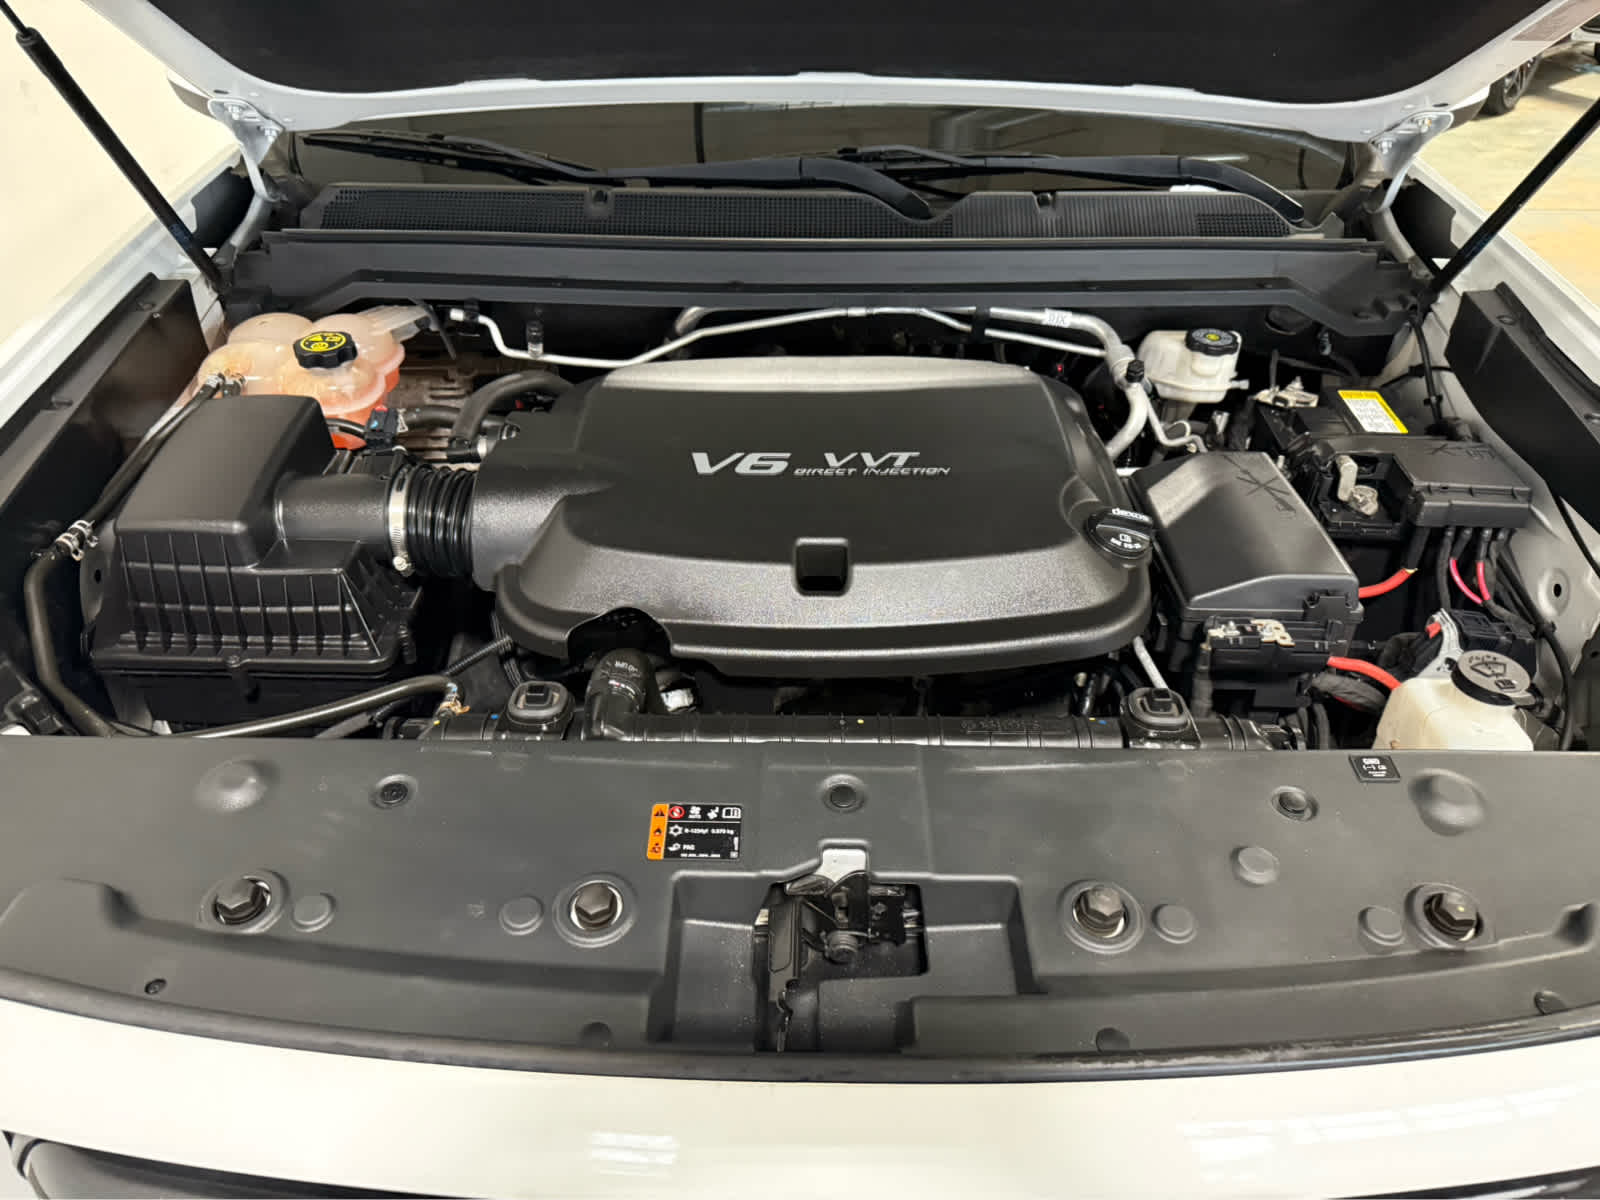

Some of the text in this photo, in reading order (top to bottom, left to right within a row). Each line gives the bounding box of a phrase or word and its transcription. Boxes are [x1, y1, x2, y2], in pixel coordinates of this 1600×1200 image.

[692, 451, 921, 475] V6 VVT
[793, 466, 951, 477] DIRECT INJECTION
